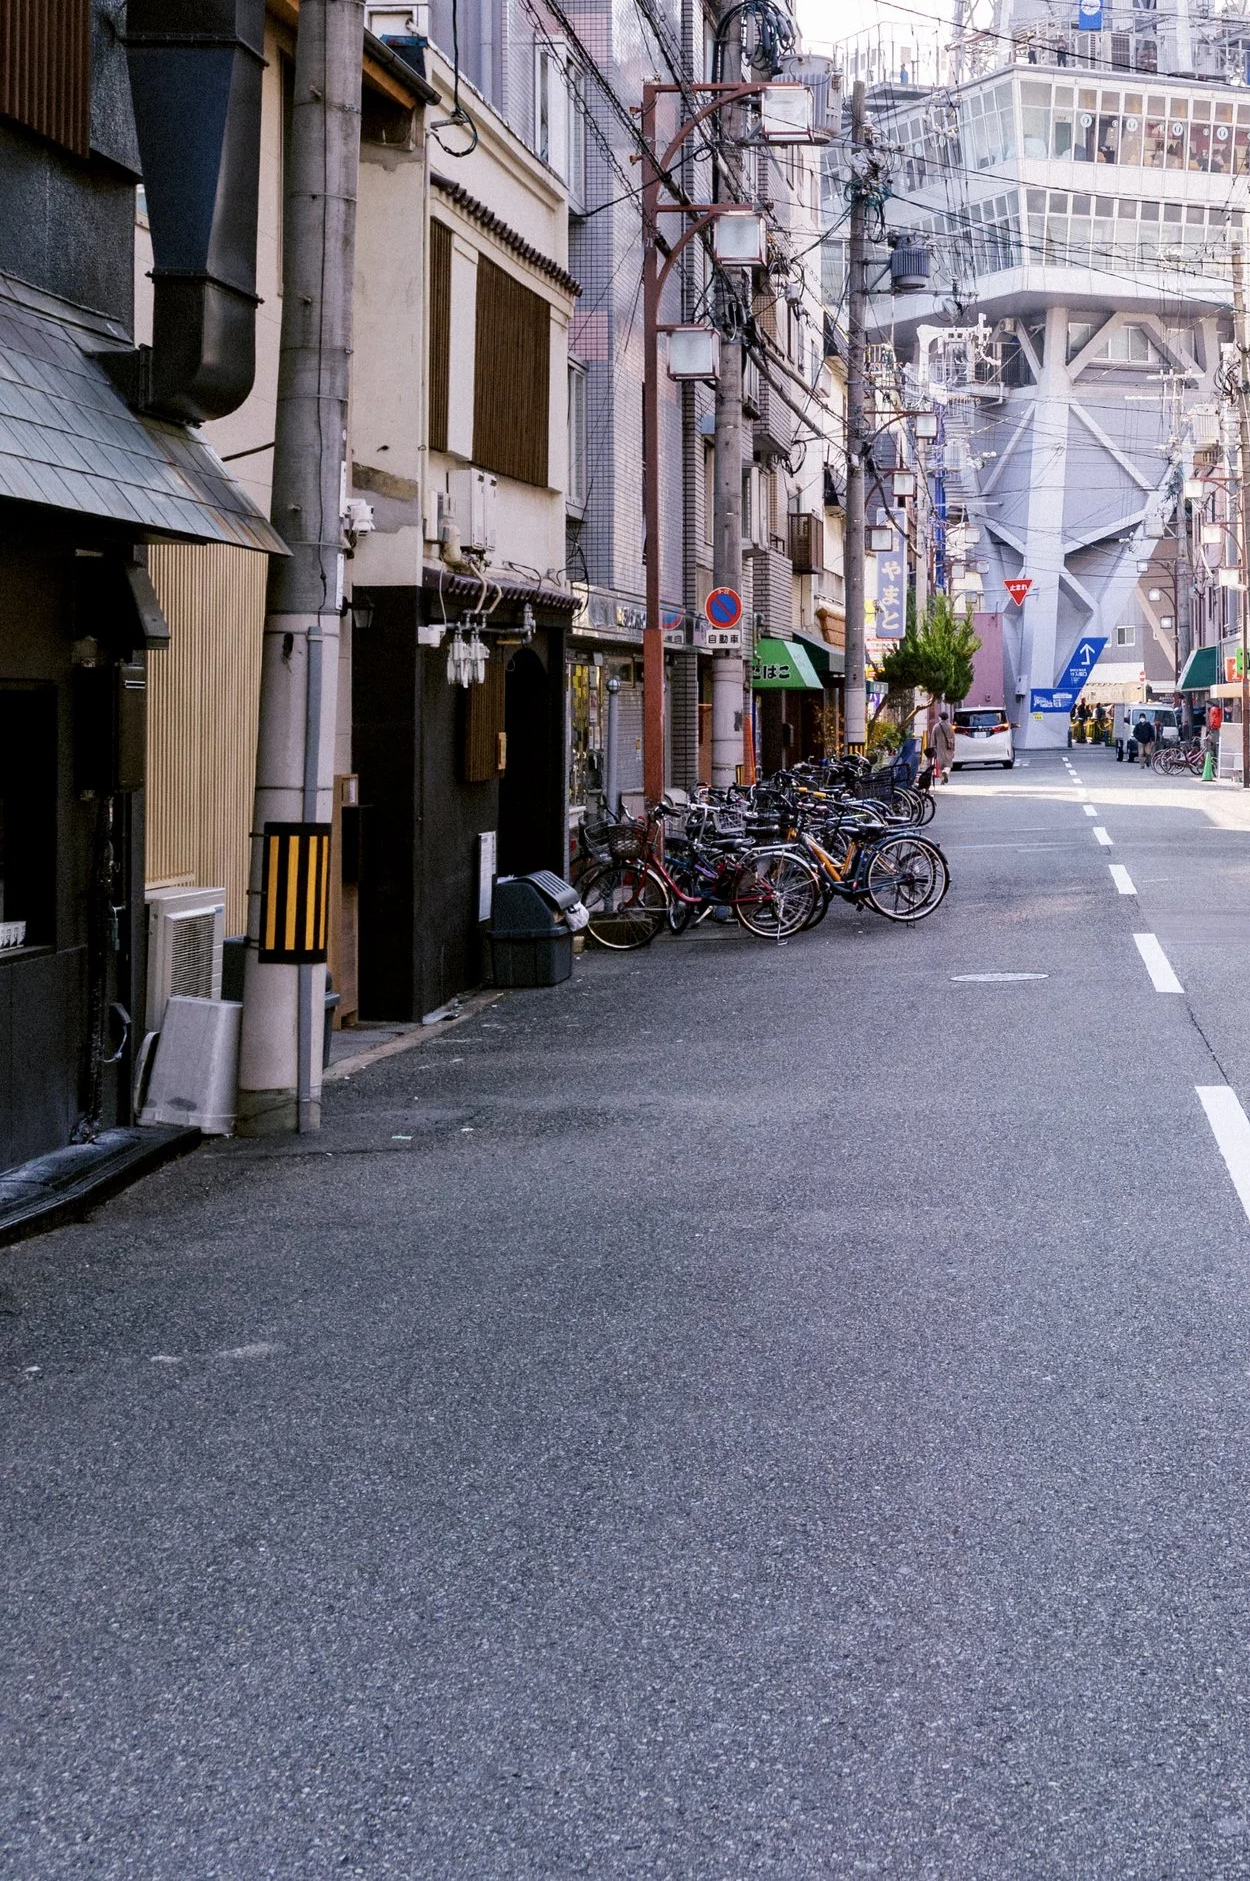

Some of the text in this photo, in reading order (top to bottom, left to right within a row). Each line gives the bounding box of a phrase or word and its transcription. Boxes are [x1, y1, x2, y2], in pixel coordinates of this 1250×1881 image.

[1009, 584, 1027, 592] 止まれ
[708, 634, 739, 644] 自動車
